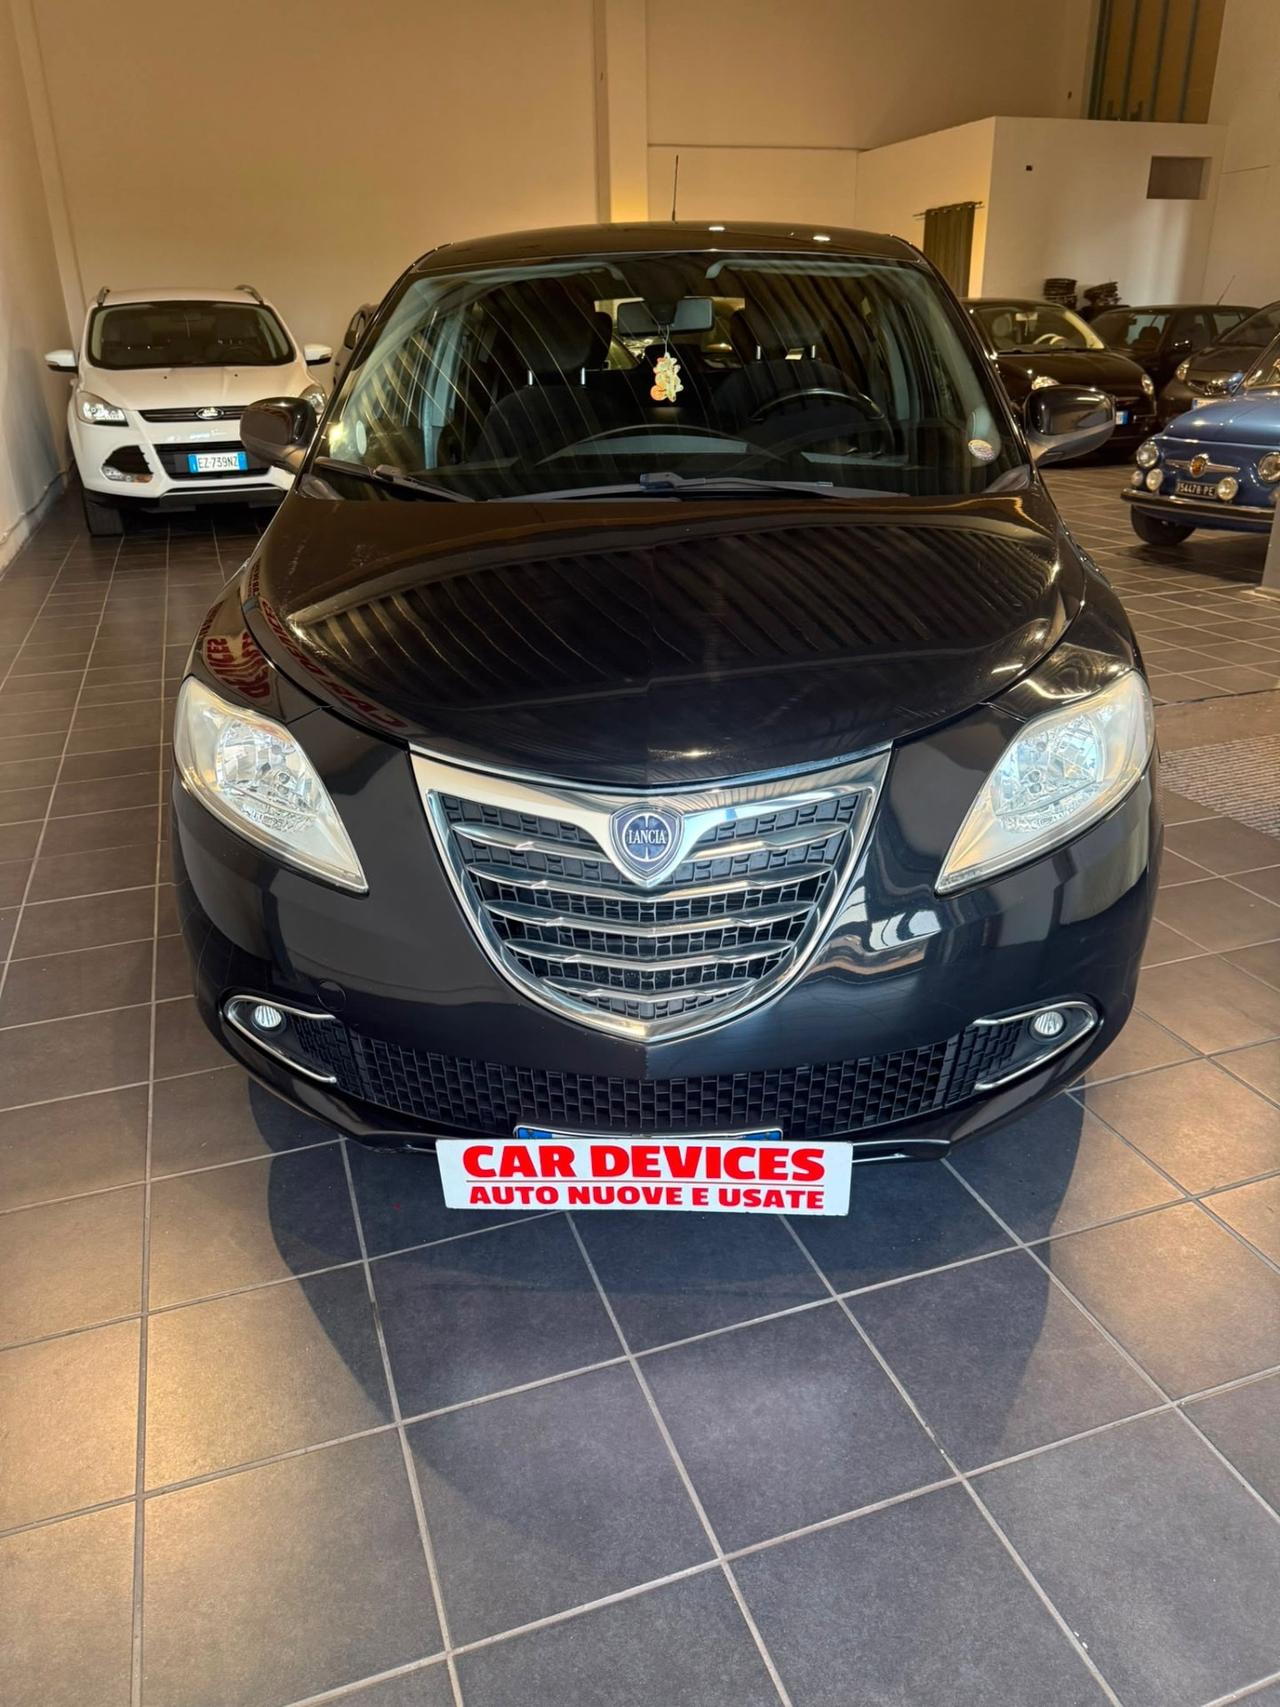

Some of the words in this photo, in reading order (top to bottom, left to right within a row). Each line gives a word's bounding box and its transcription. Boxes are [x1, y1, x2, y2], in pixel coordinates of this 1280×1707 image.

[628, 829, 667, 845] LANCIA
[463, 1146, 576, 1177] CAR
[591, 1146, 824, 1181] DEVICES
[470, 1187, 558, 1204] AUTO
[568, 1187, 682, 1204] NUOVE
[693, 1188, 708, 1205] E
[719, 1189, 823, 1208] USATE
